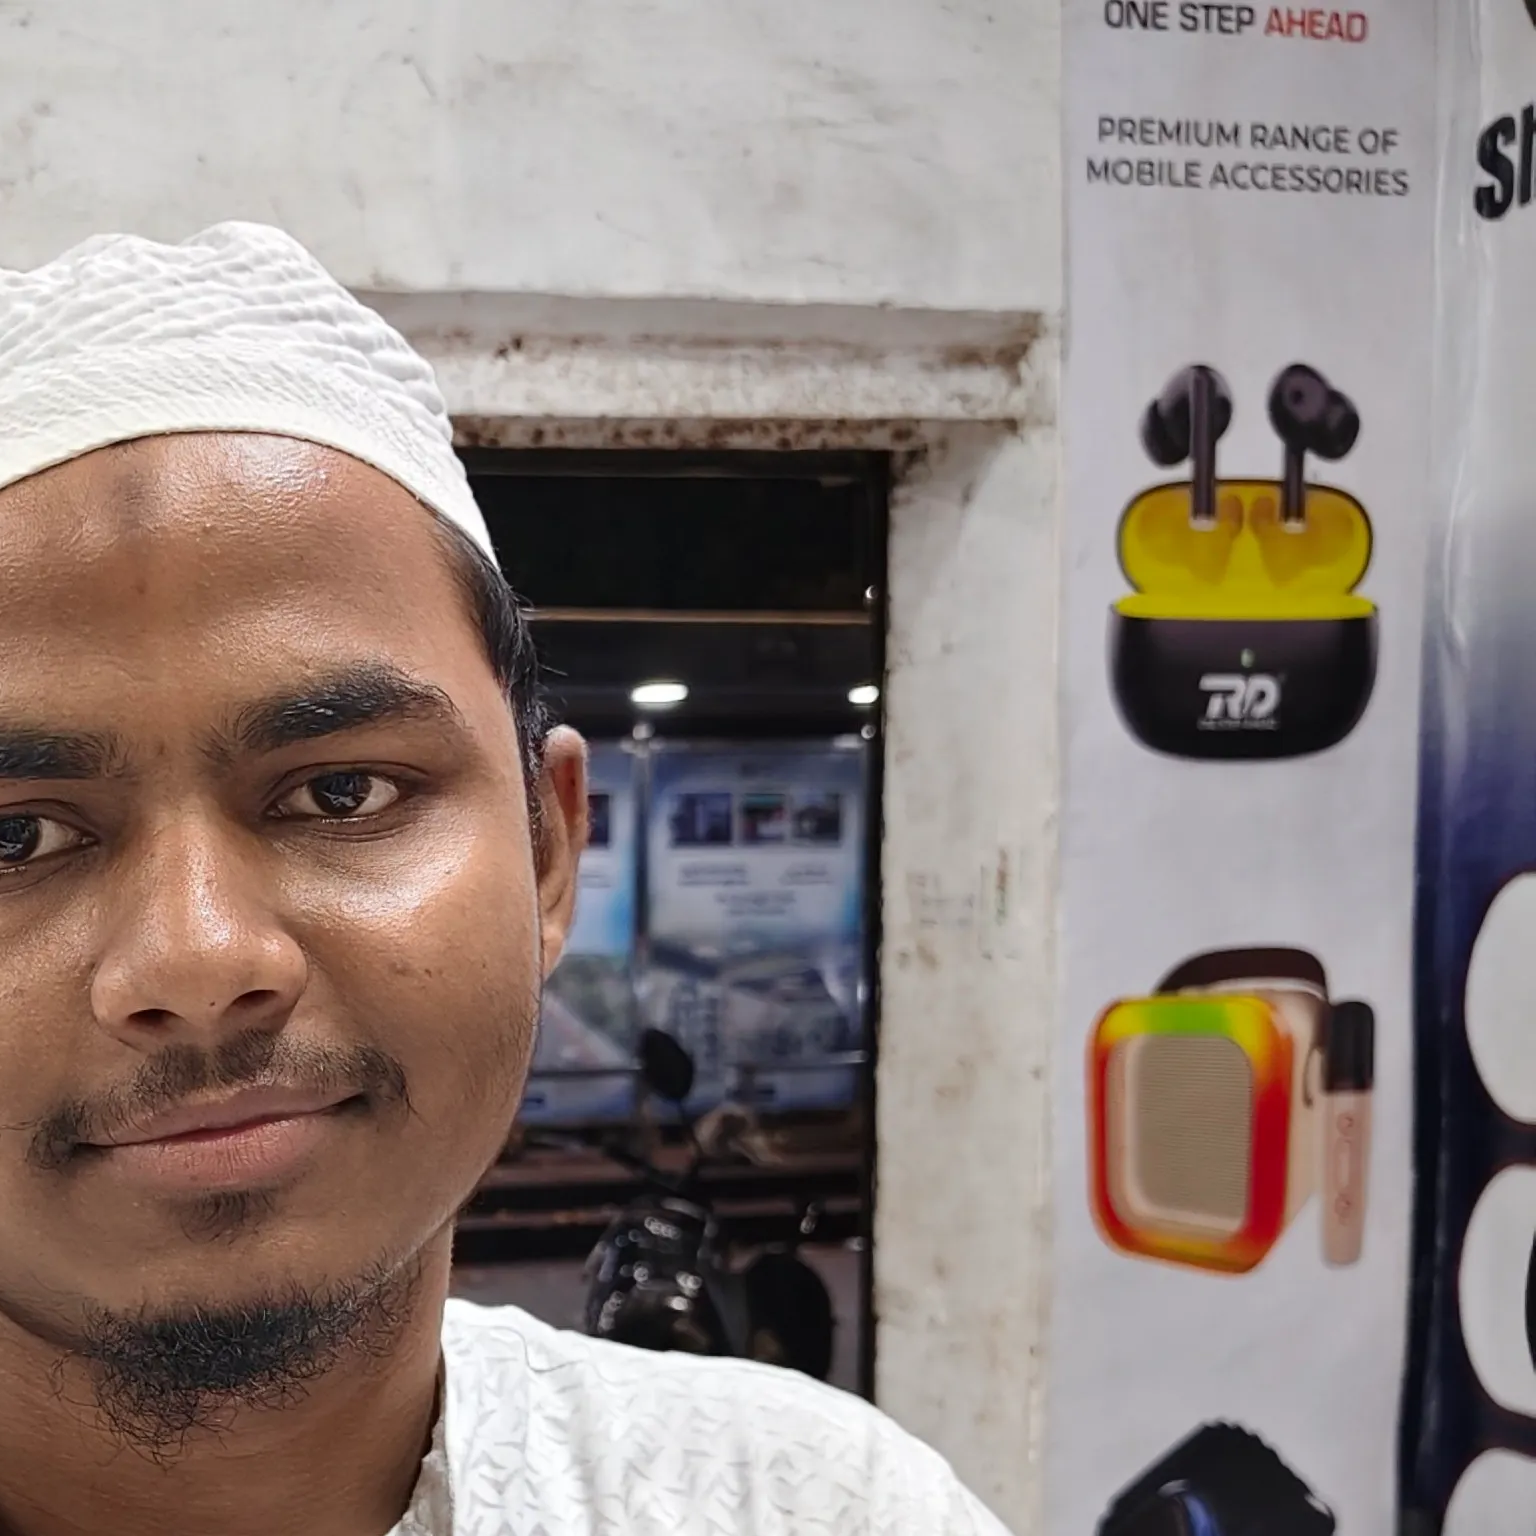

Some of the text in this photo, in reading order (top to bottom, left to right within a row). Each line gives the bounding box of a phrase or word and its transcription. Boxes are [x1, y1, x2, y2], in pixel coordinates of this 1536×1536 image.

[1104, 0, 1369, 43] ONE STEP AHEAD
[1098, 115, 1400, 156] PREMIUM RANGE OF
[1086, 156, 1409, 197] MOBILE ACCESSORIES
